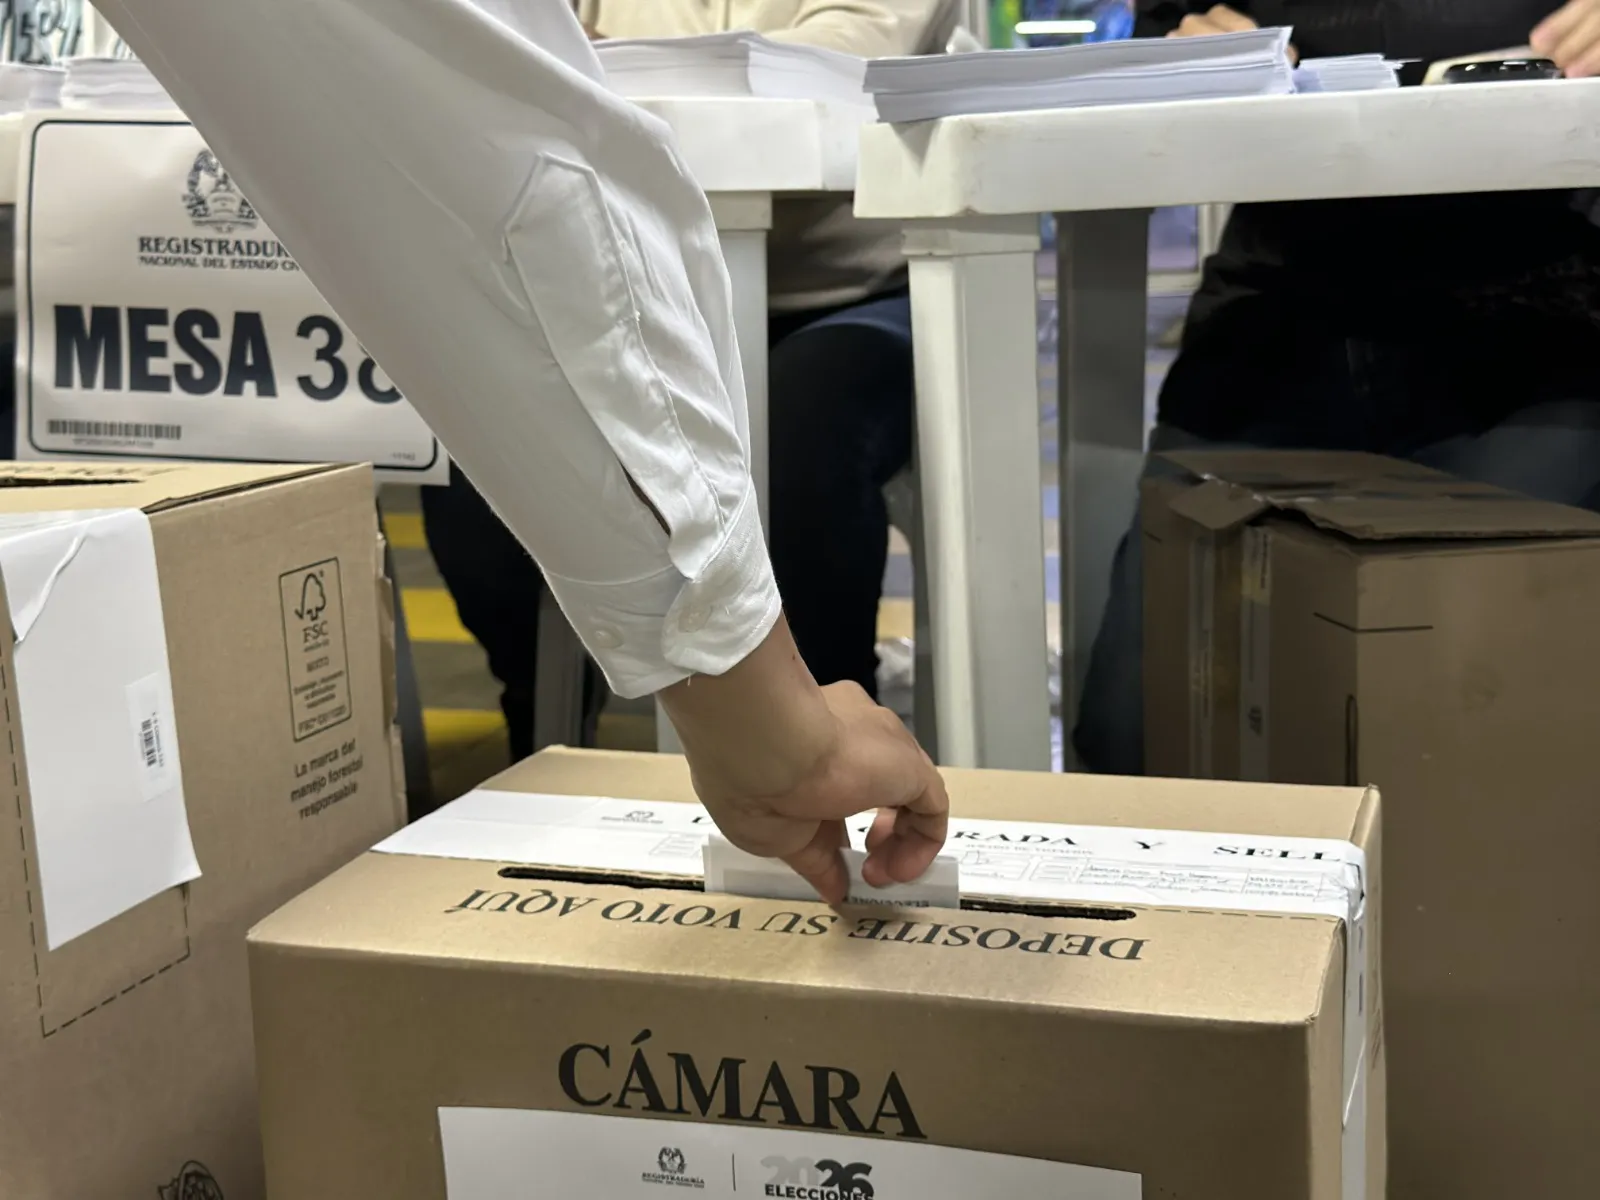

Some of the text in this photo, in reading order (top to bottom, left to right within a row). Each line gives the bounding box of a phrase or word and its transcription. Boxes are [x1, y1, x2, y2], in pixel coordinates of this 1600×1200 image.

[202, 258, 228, 269] DEL
[54, 304, 278, 398] MESA
[302, 620, 329, 644] FSC
[293, 737, 356, 778] La marca del
[290, 754, 363, 802] manejo forestal
[299, 781, 358, 820] responsable
[951, 830, 1078, 846] RADA
[1135, 840, 1166, 850] Y
[601, 900, 742, 929] VOTO
[754, 911, 838, 934] SU
[848, 917, 1150, 960] DEPOSITE
[558, 1028, 927, 1139] CÁMARA
[760, 1155, 874, 1200] 2026
[765, 1184, 874, 1200] ELECCIONES
